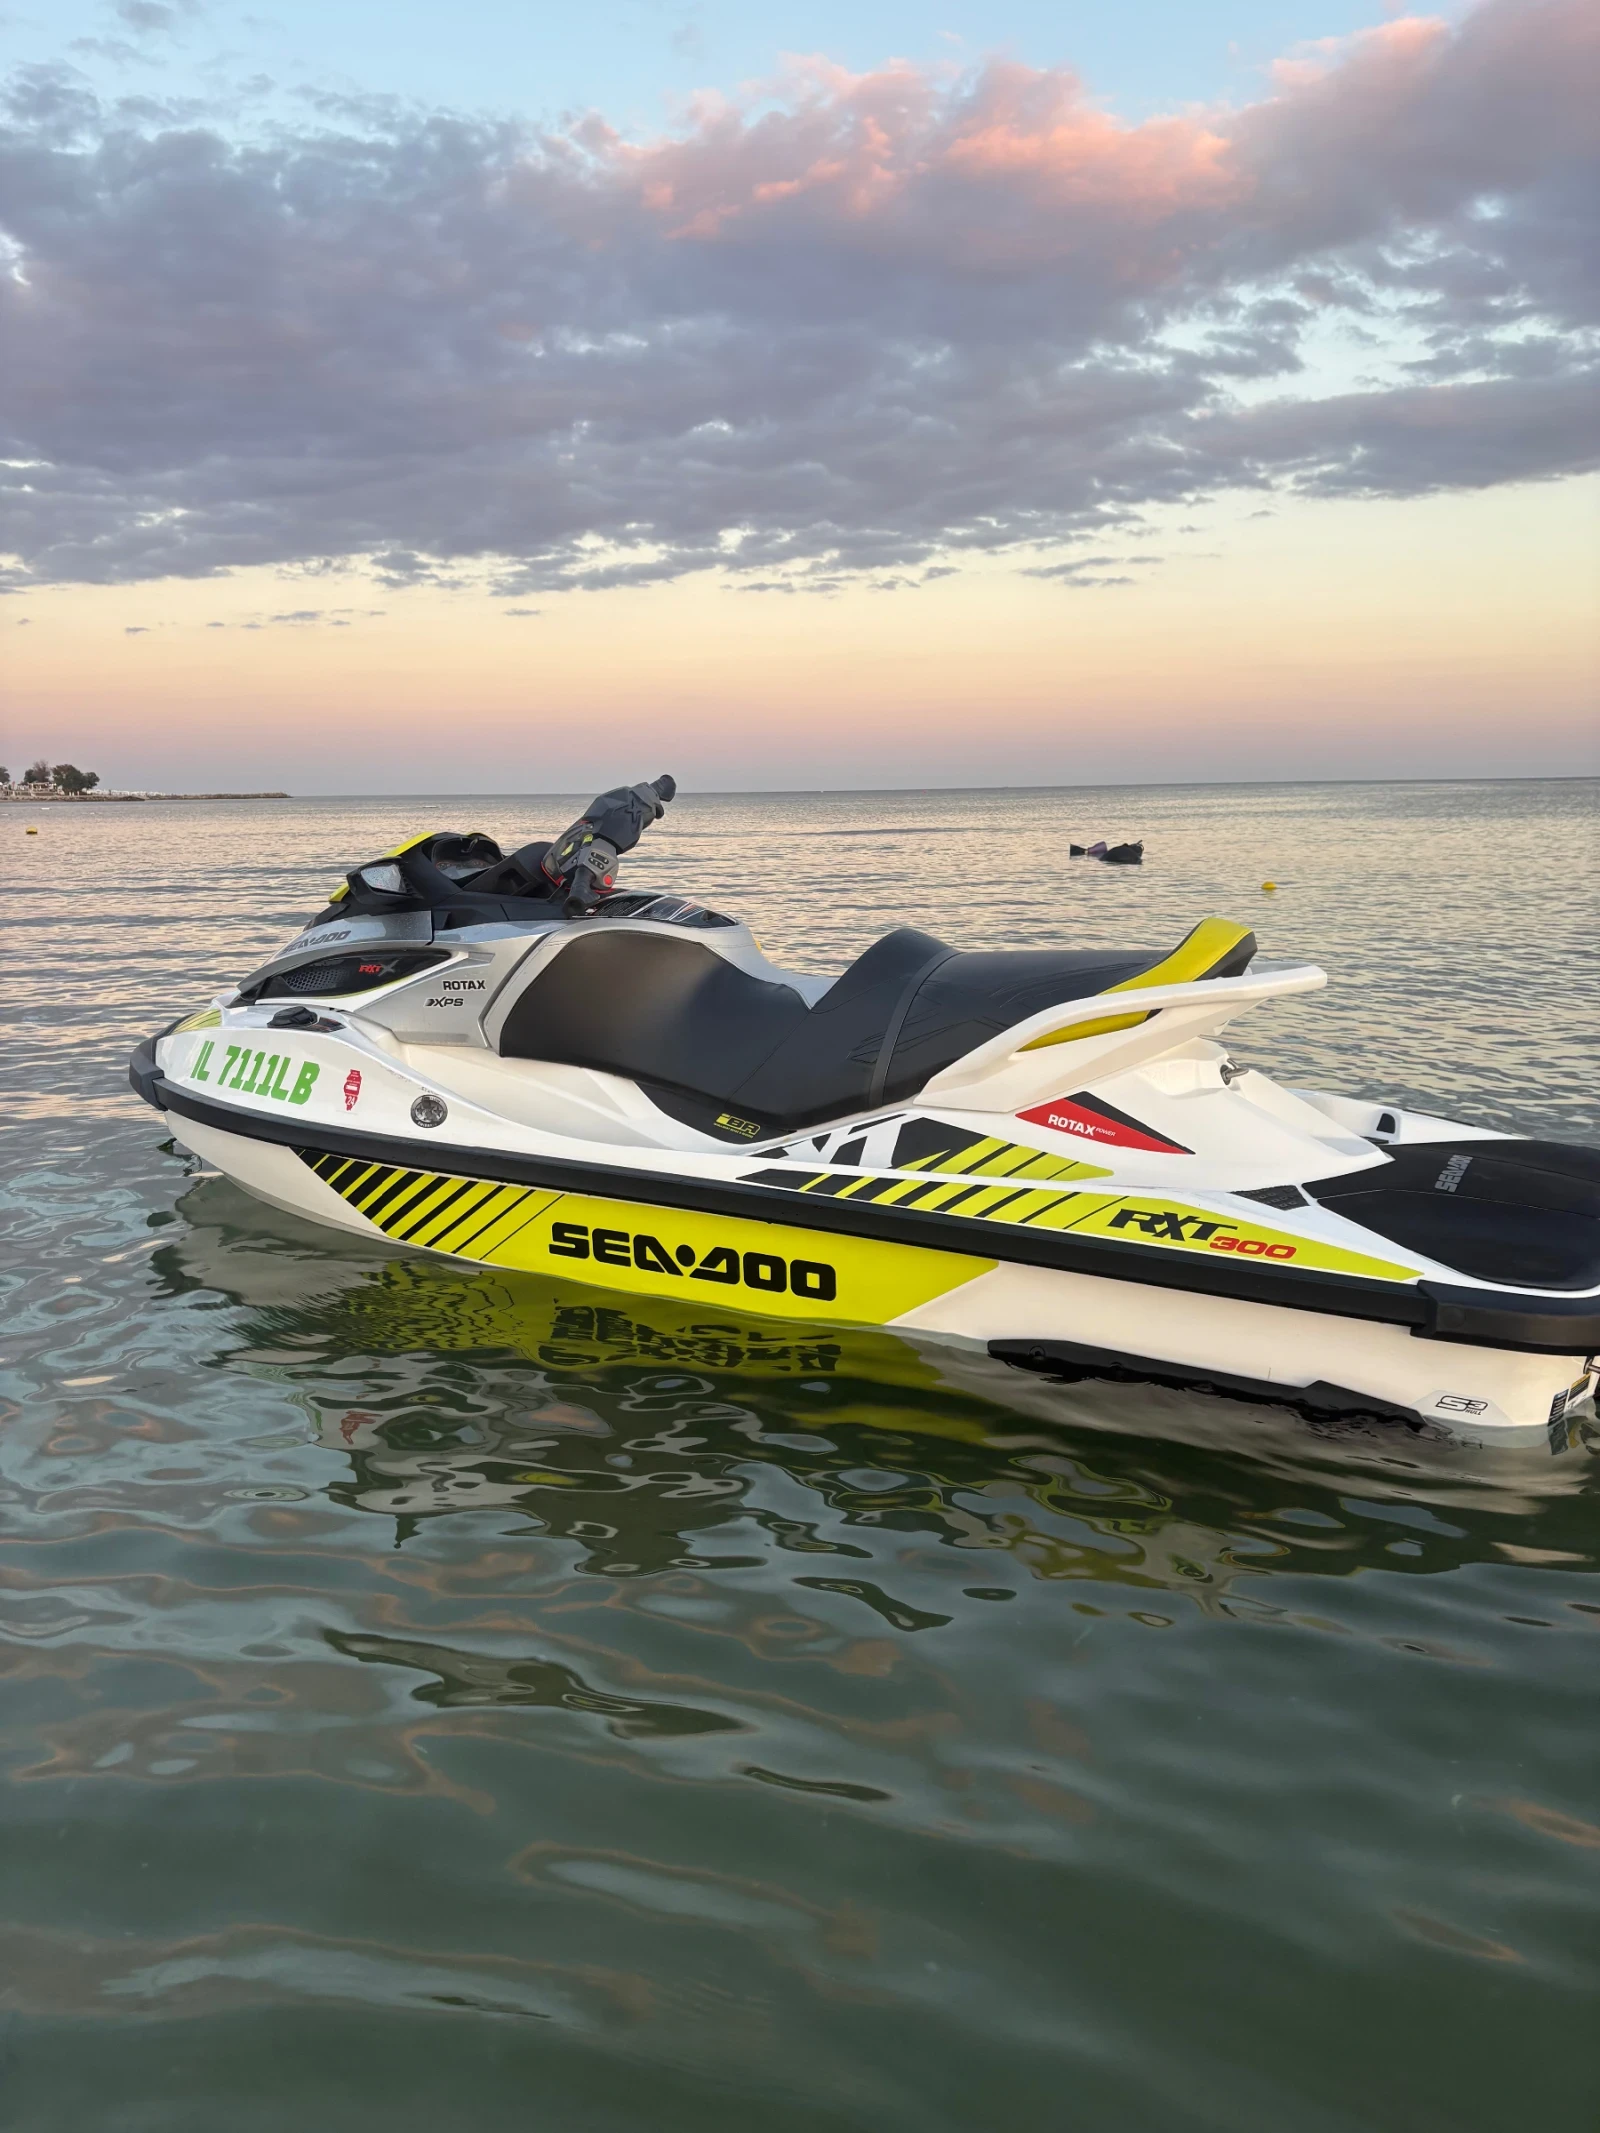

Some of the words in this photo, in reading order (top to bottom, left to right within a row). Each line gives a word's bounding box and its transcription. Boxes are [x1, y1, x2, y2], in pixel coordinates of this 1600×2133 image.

[443, 980, 486, 990] ROTAX
[434, 996, 464, 1007] XPS
[190, 1040, 215, 1081] IL
[217, 1045, 320, 1105] 7111LB
[1047, 1114, 1097, 1136] ROTAX
[1095, 1127, 1116, 1137] POWER
[1107, 1208, 1238, 1241] RXT
[1209, 1236, 1297, 1259] 300
[1435, 1395, 1488, 1412] S3
